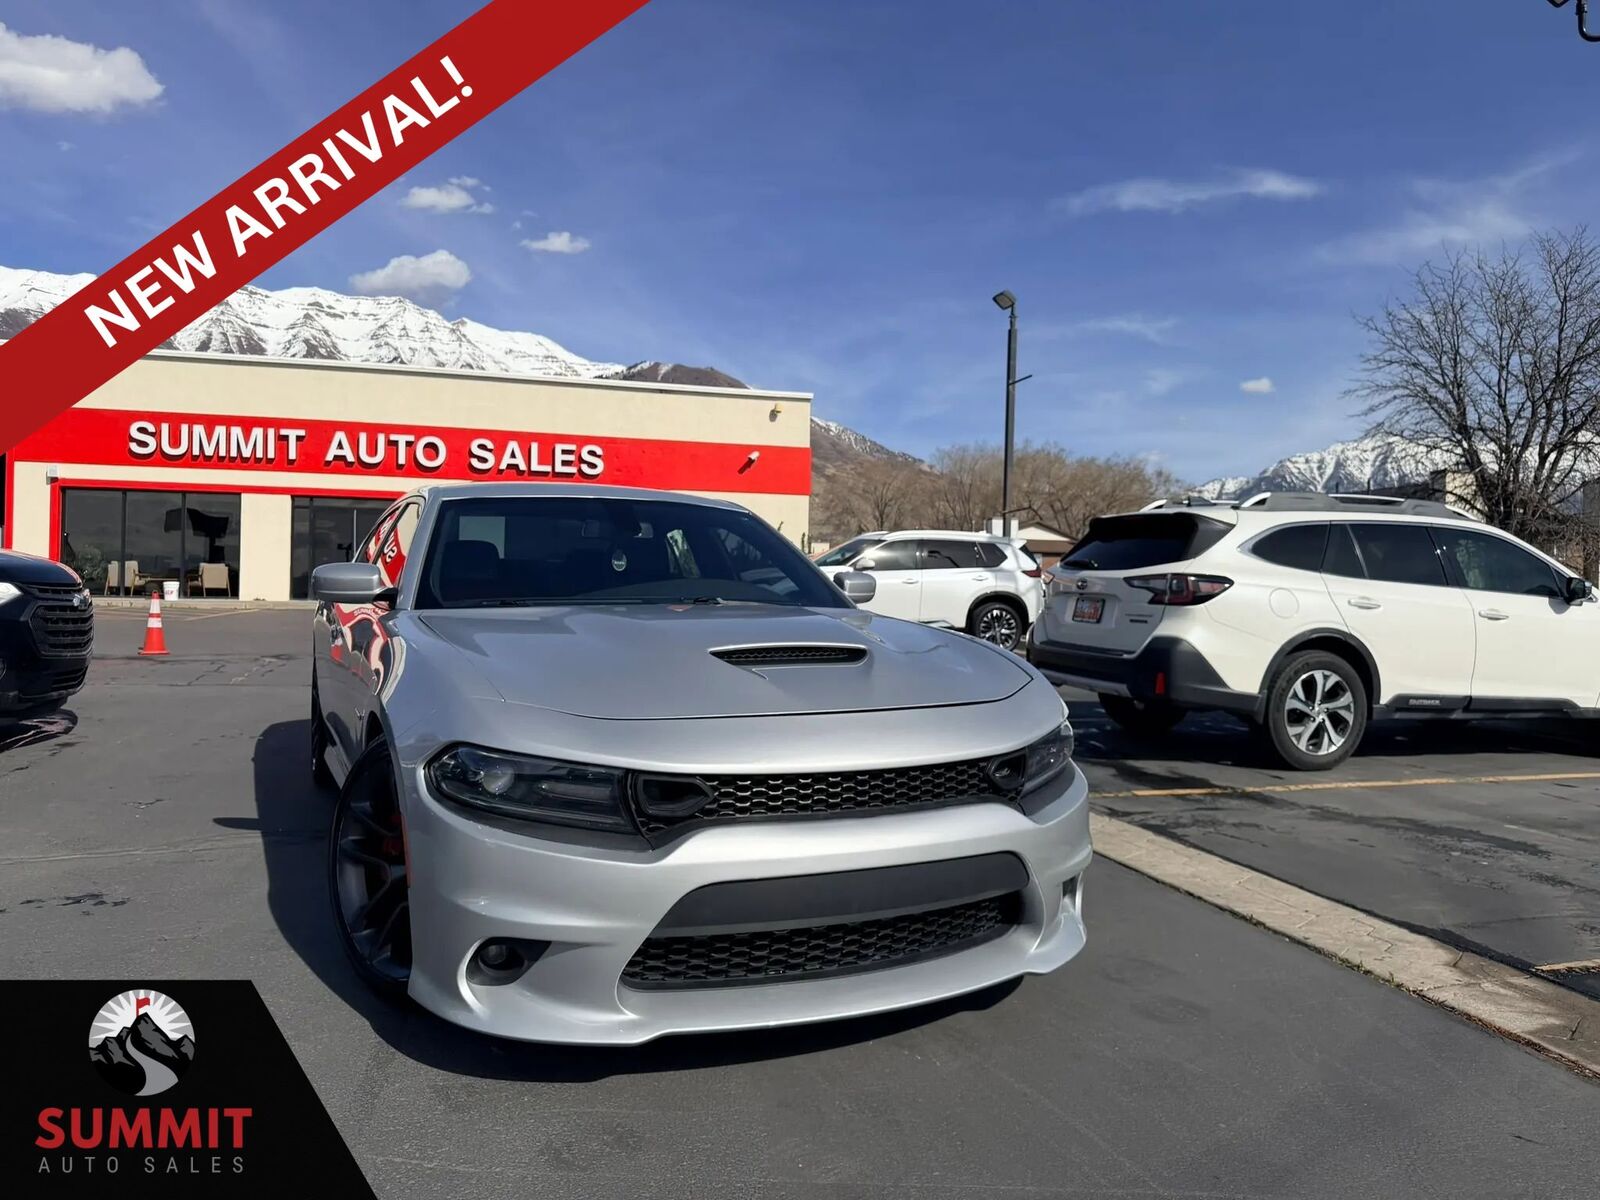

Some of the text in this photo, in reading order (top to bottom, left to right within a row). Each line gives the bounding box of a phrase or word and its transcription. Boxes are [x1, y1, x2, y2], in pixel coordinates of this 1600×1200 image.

[128, 420, 605, 478] SUMMIT AUTO SALES
